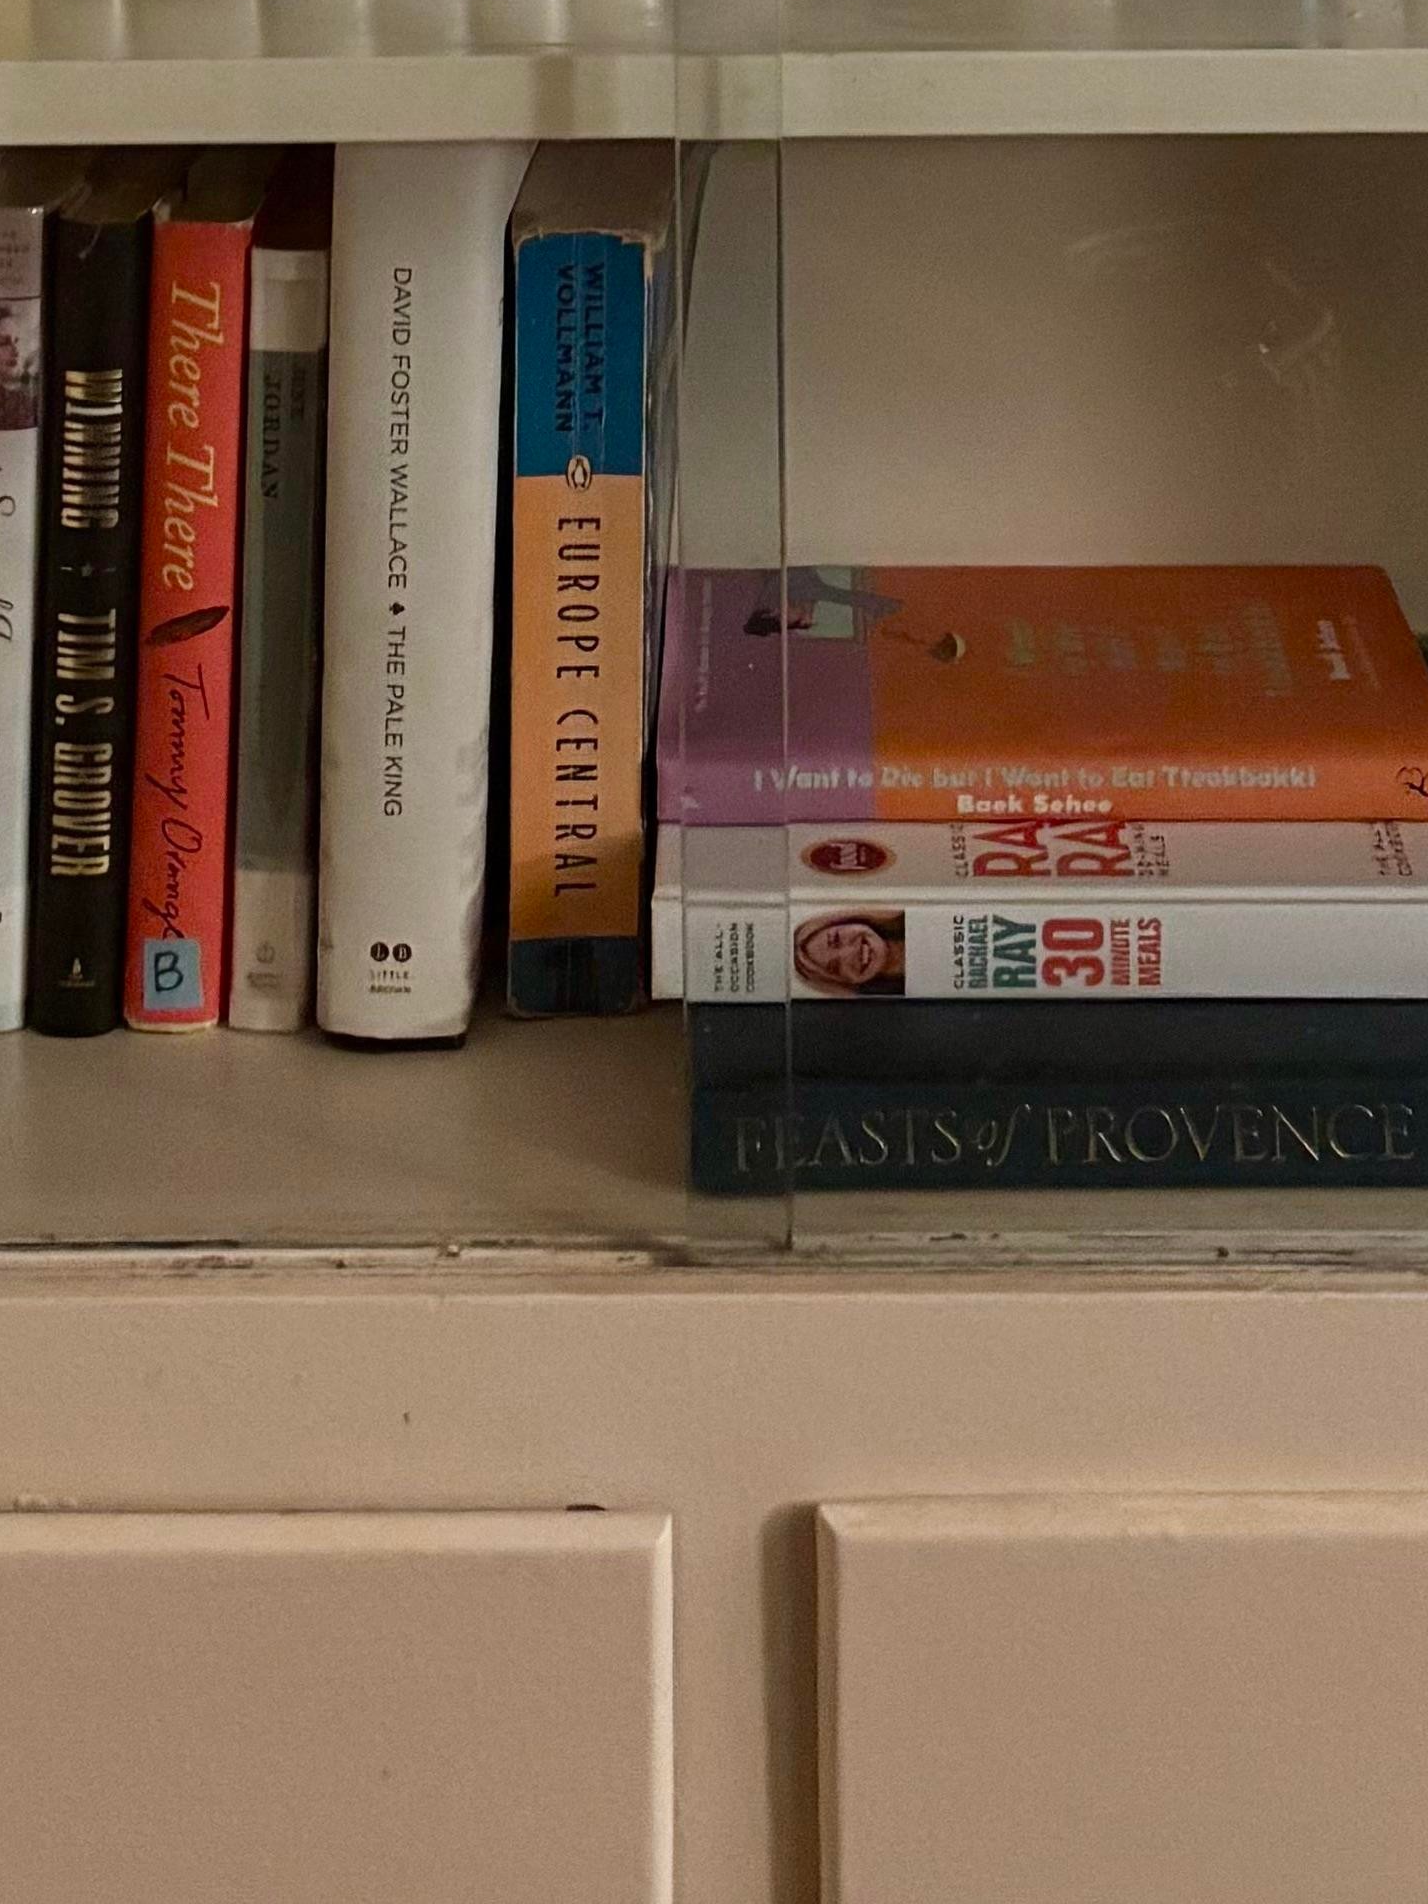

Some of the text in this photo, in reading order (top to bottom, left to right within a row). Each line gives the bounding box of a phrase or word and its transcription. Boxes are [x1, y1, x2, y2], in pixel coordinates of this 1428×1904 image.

[159, 280, 225, 593] There There
[385, 267, 415, 590] DAVID FOSTER WALLACE
[382, 625, 408, 819] THE PALE KING
[551, 515, 602, 899] EUROPE CENTRAL
[956, 793, 1113, 815] Baek Sehee
[953, 914, 965, 990] CLASSIC
[968, 914, 989, 991] RACHAEL
[991, 912, 1037, 990] RAY
[1041, 916, 1106, 988] 30
[1111, 915, 1131, 988] MINUTE
[1137, 916, 1162, 988] MEALS
[734, 1098, 1414, 1172] FEASTS PROVENCE
